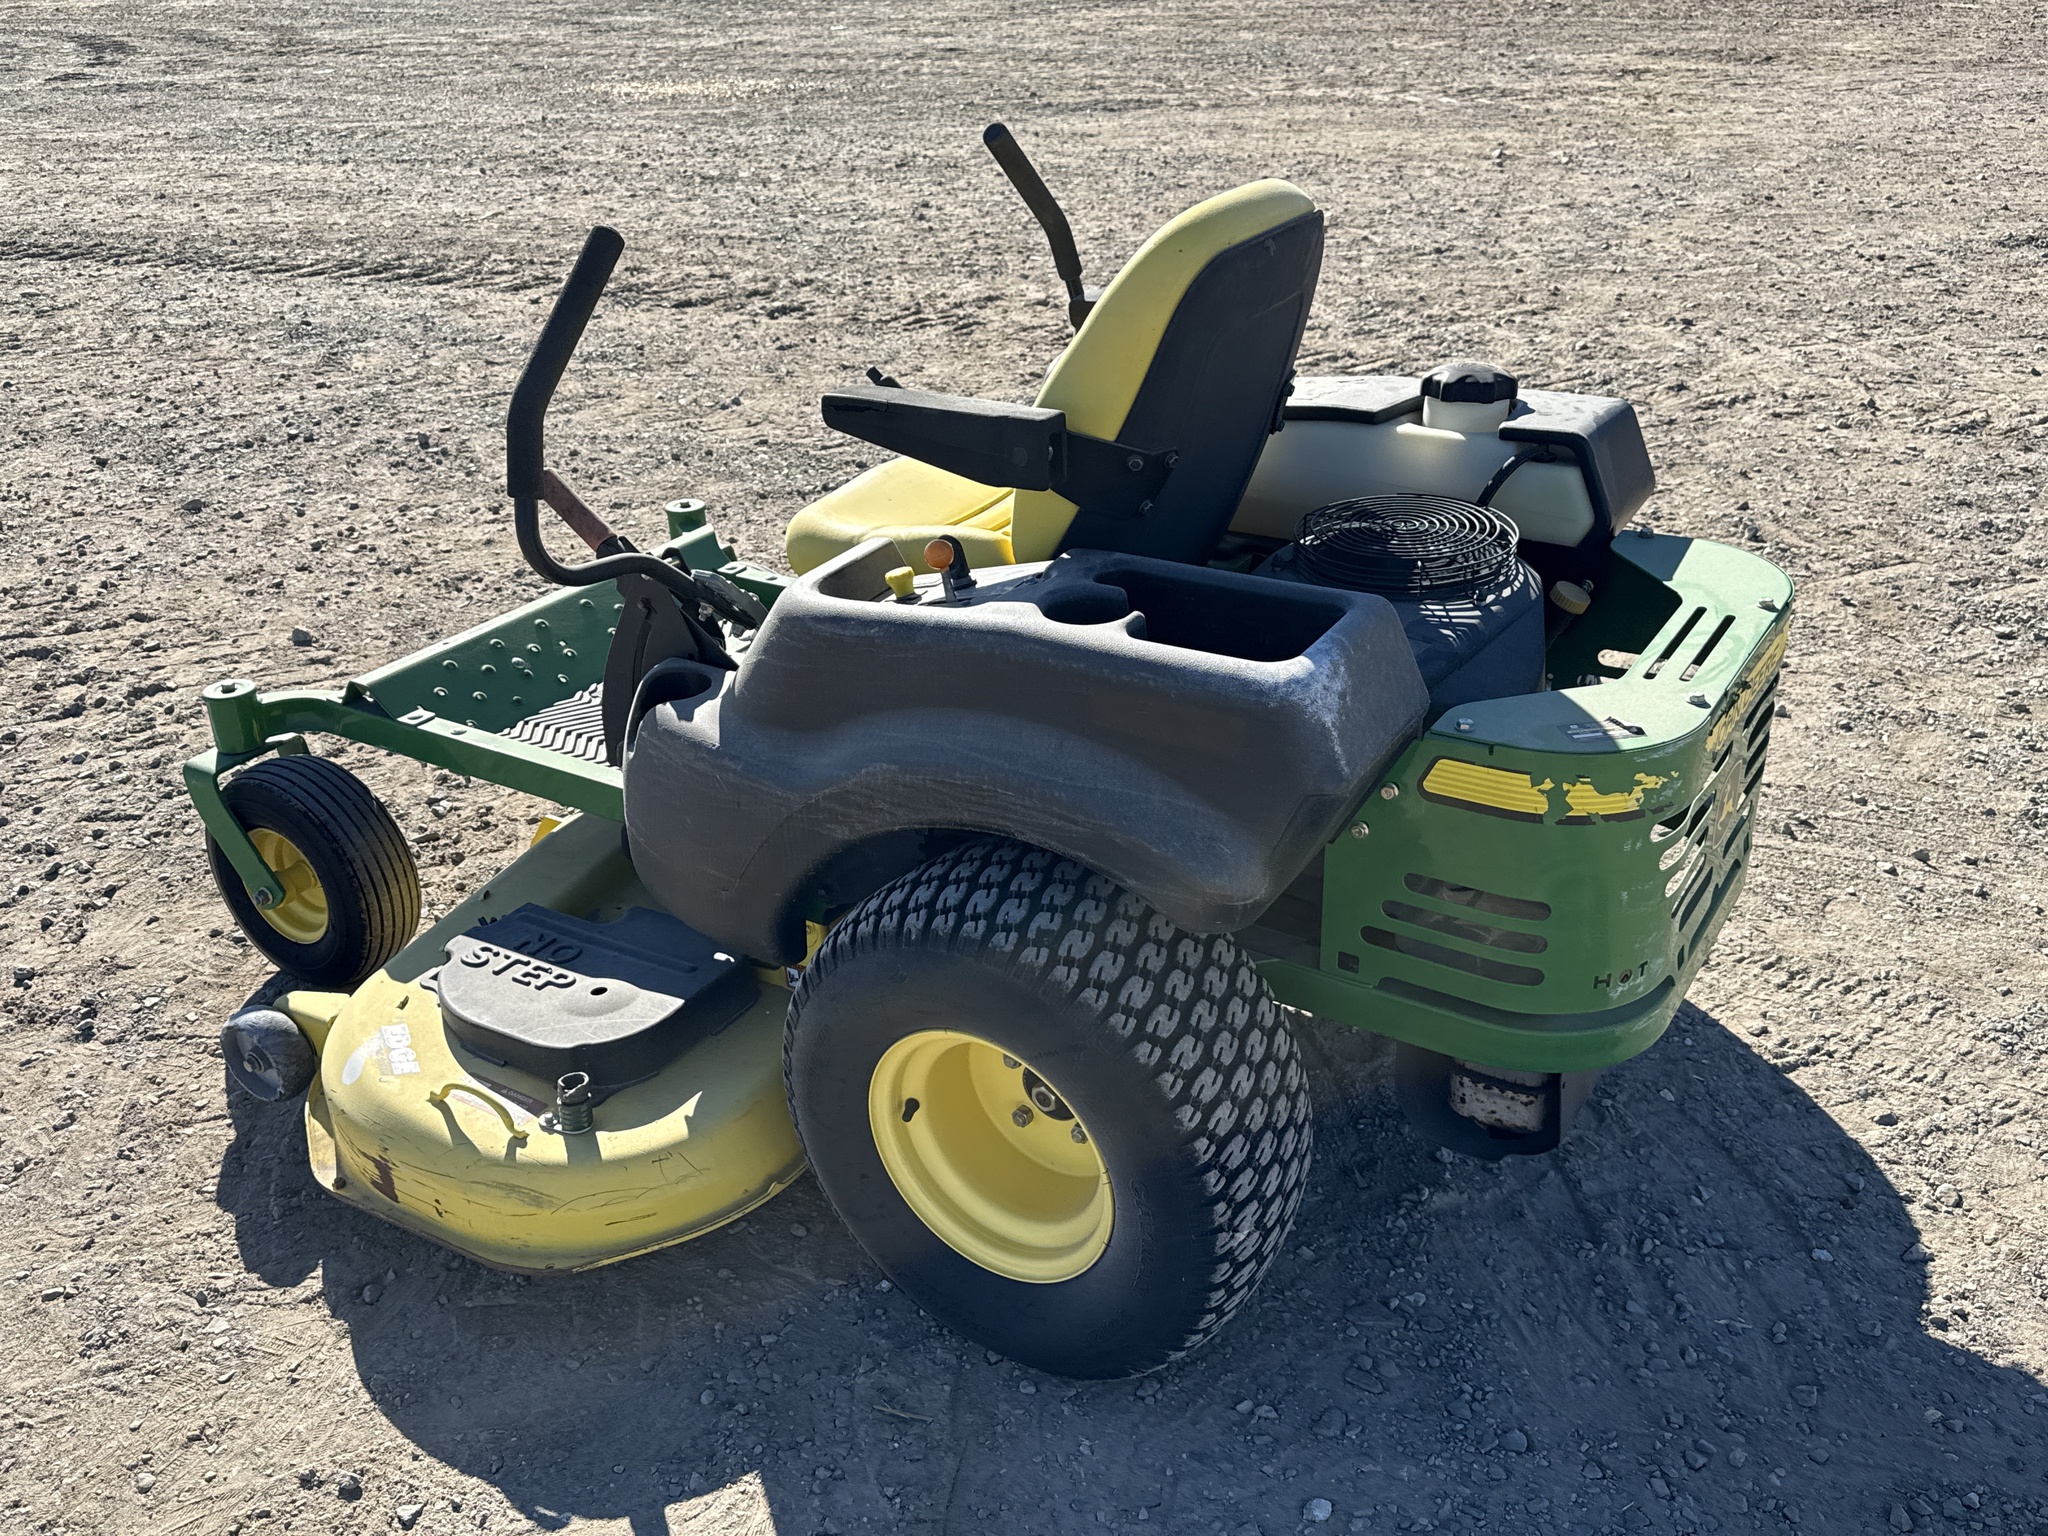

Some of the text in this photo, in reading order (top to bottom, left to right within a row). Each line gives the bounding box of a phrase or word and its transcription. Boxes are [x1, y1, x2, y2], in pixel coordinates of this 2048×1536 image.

[513, 932, 583, 965] NO
[461, 944, 578, 991] STEP
[1592, 960, 1649, 990] HOT
[507, 1087, 535, 1105] DANGER
